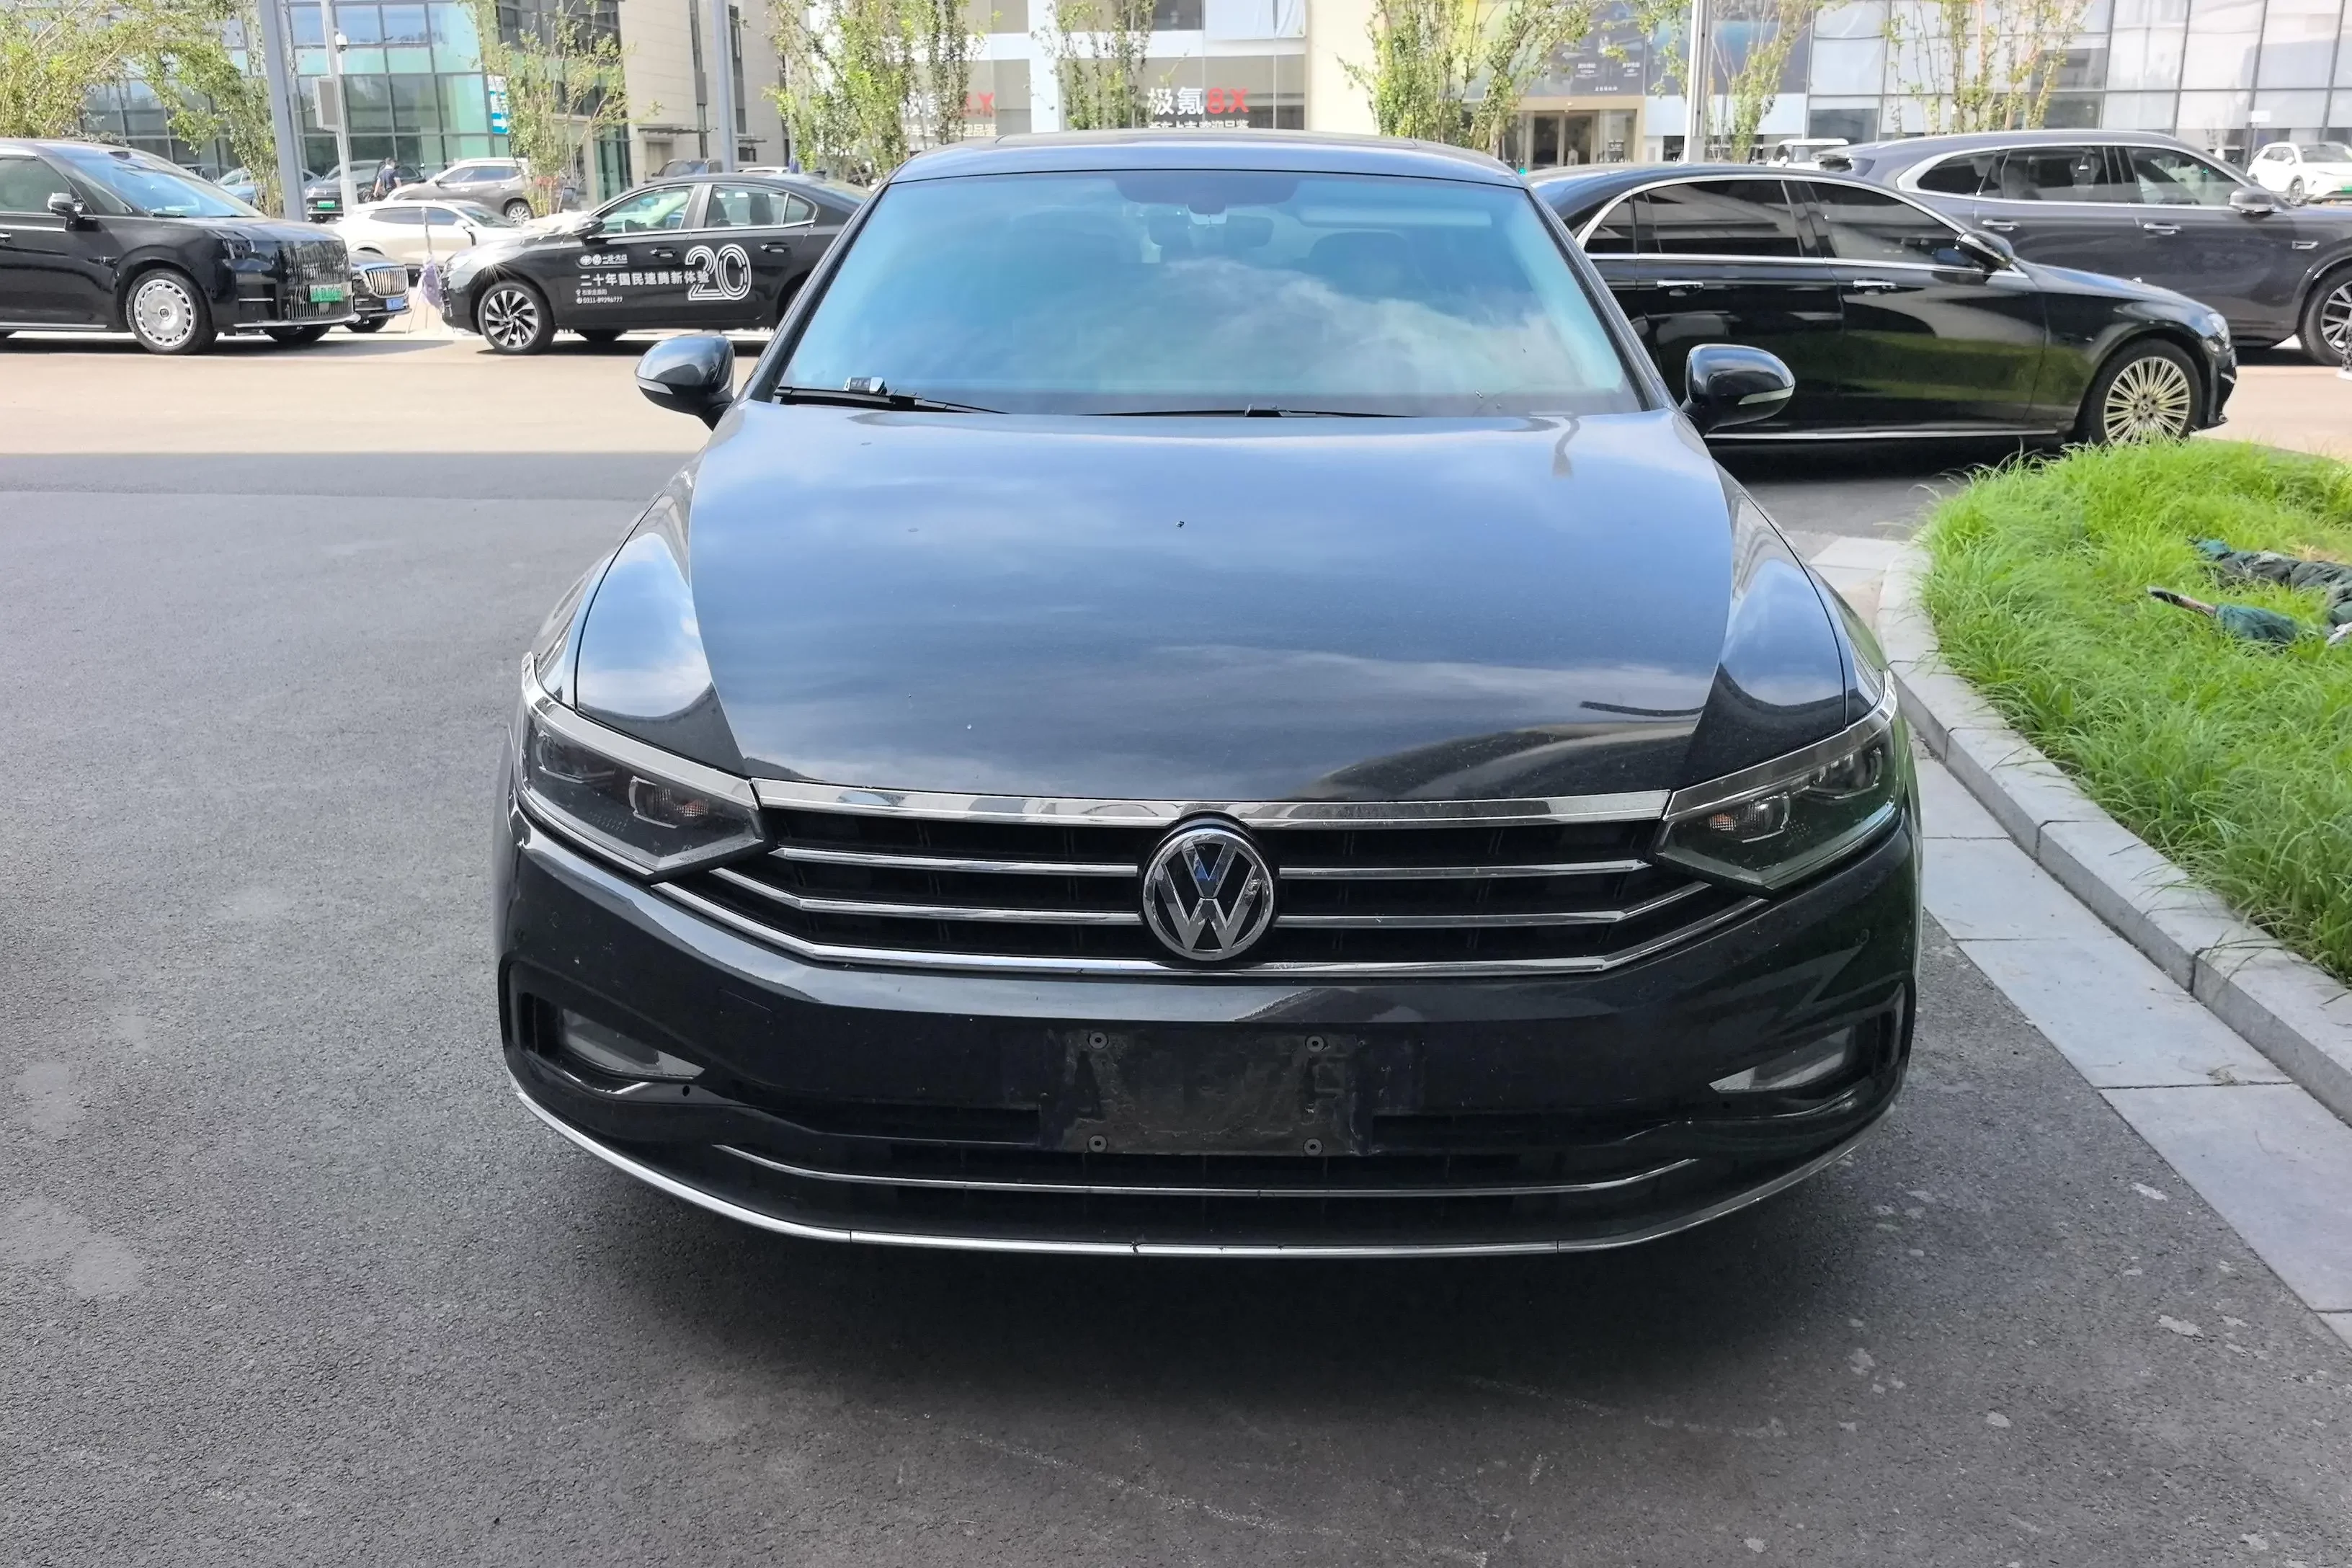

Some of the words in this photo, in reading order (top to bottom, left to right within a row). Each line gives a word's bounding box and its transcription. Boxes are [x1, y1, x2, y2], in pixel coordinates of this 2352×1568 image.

[1147, 86, 1250, 115] 极氪8X
[580, 271, 710, 287] 二十年国民速腾新体验
[685, 244, 752, 300] 20
